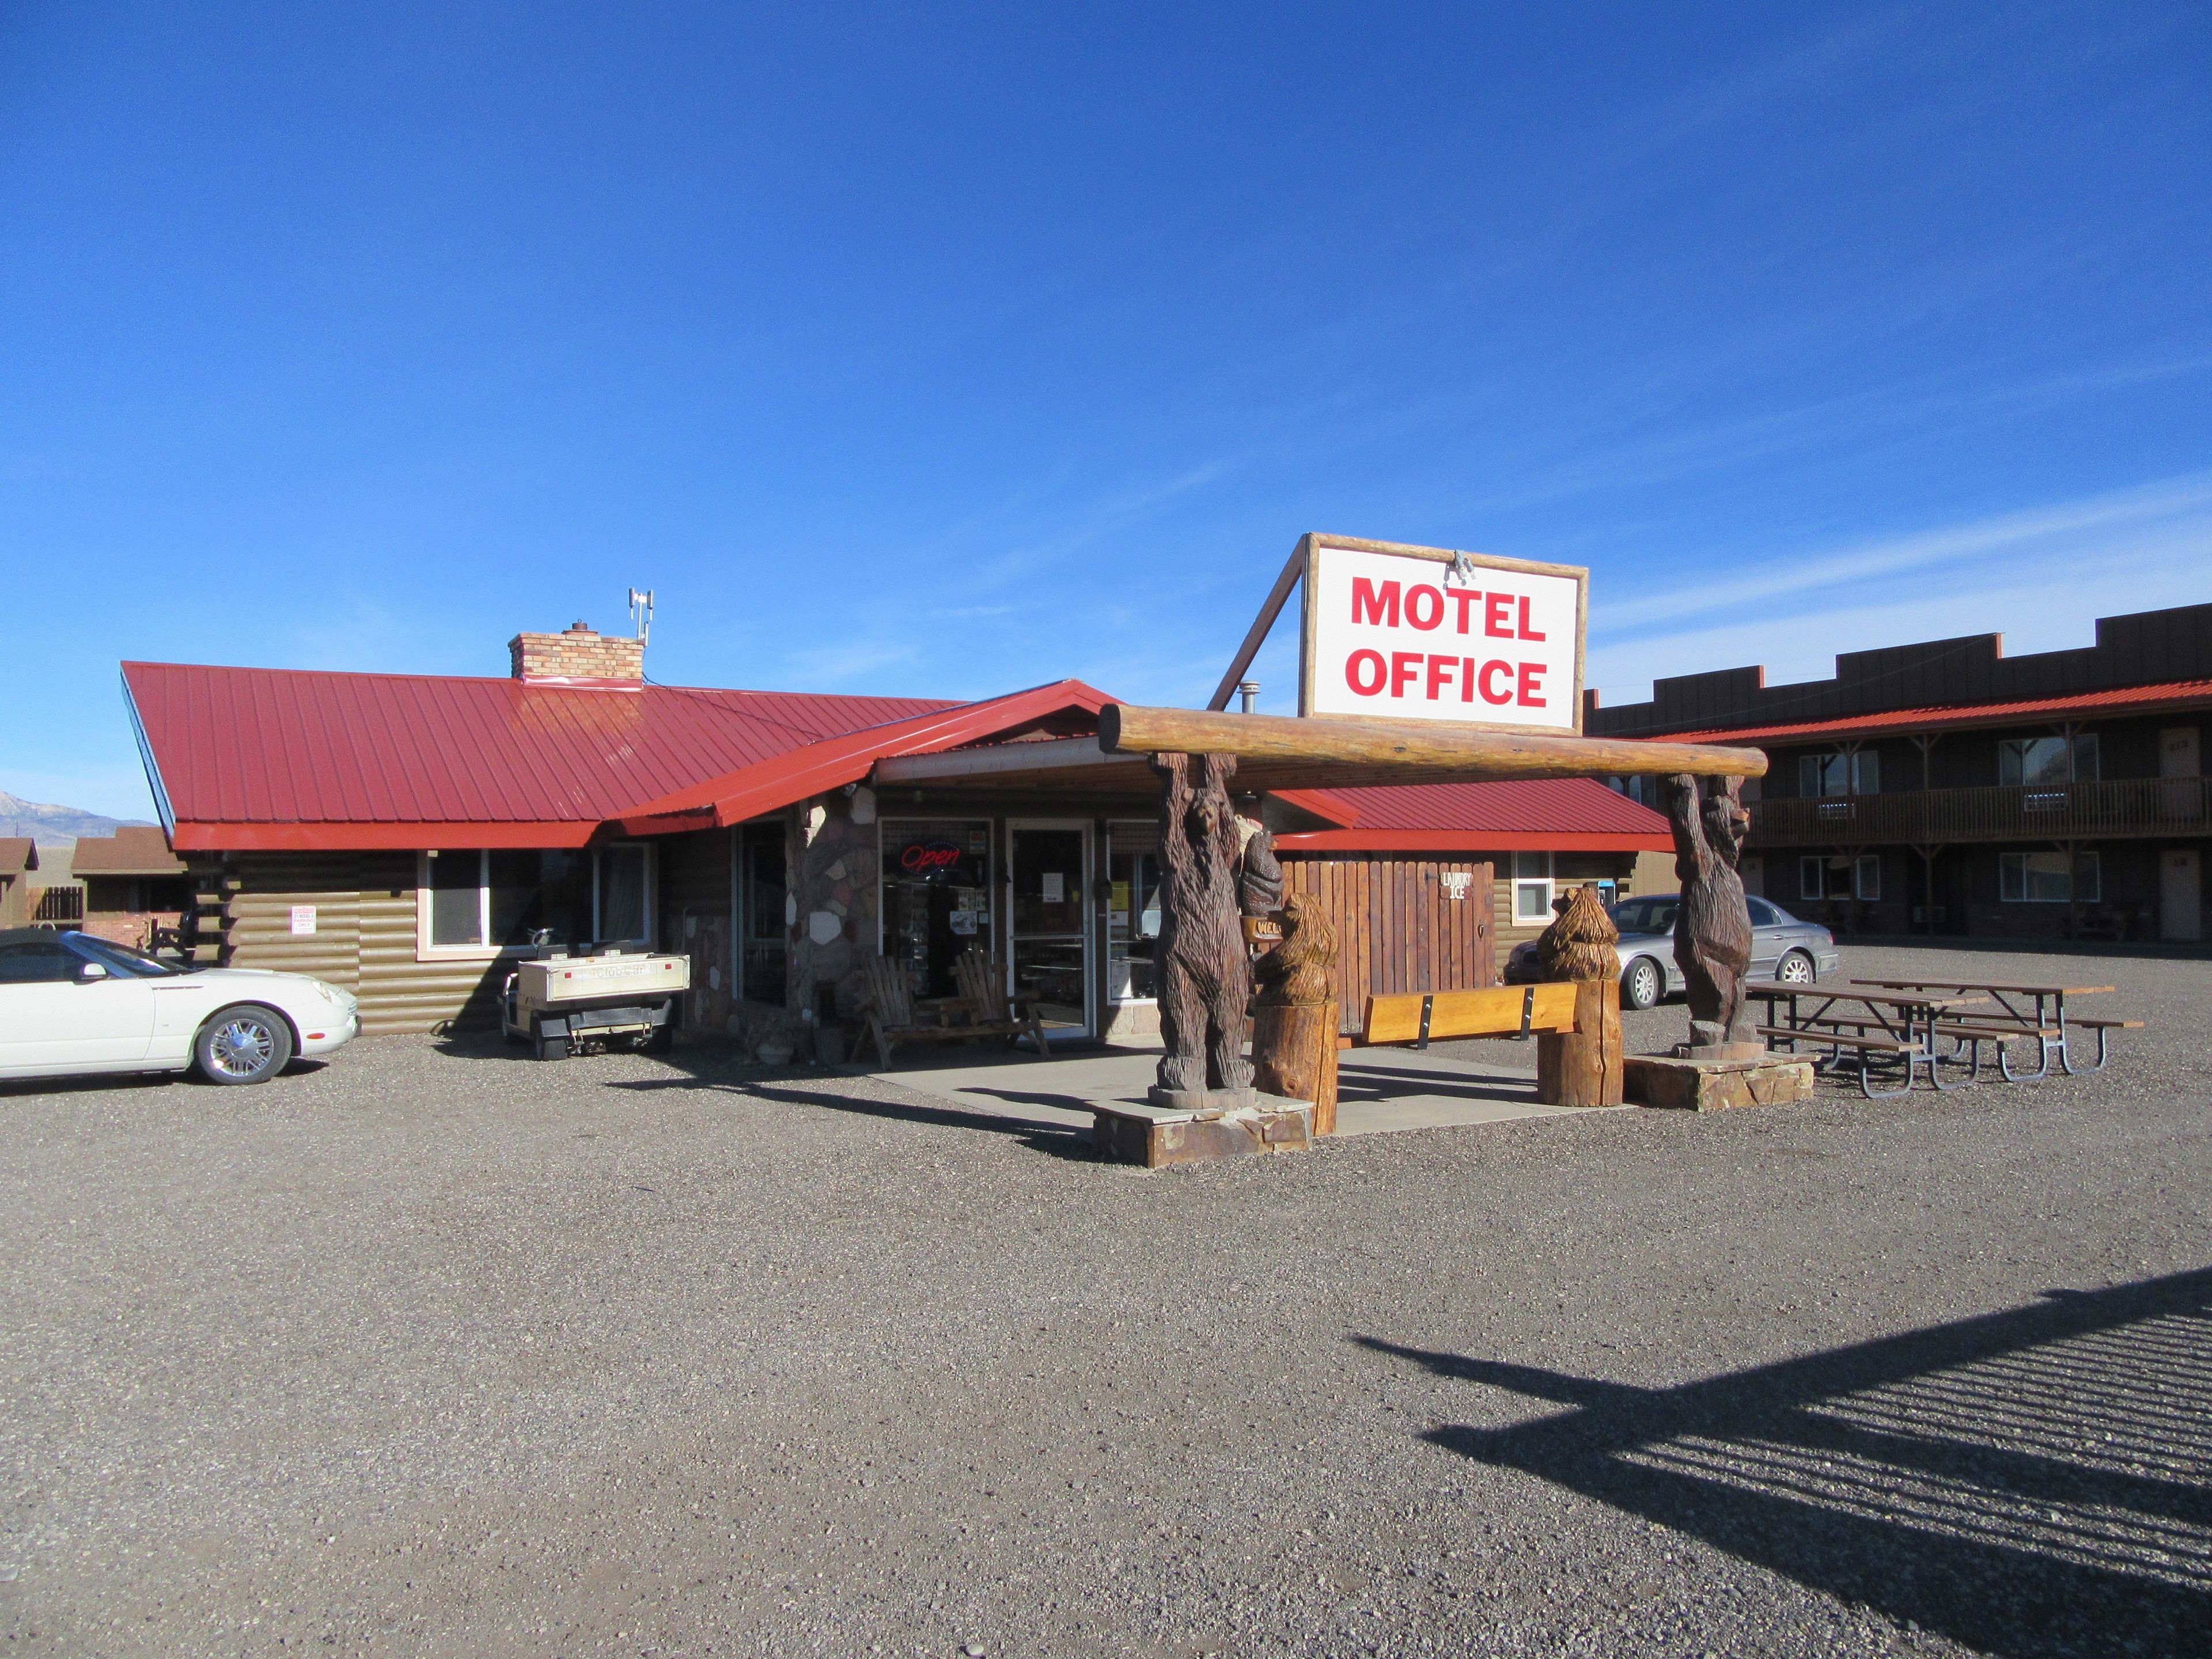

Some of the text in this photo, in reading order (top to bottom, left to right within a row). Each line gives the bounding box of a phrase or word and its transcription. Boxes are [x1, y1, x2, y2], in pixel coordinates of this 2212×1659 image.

[1351, 577, 1546, 642] MOTEL
[1345, 649, 1547, 707] OFFICE
[902, 845, 961, 872] Open
[1443, 872, 1472, 886] LAUNDRY
[1449, 885, 1464, 899] ICE
